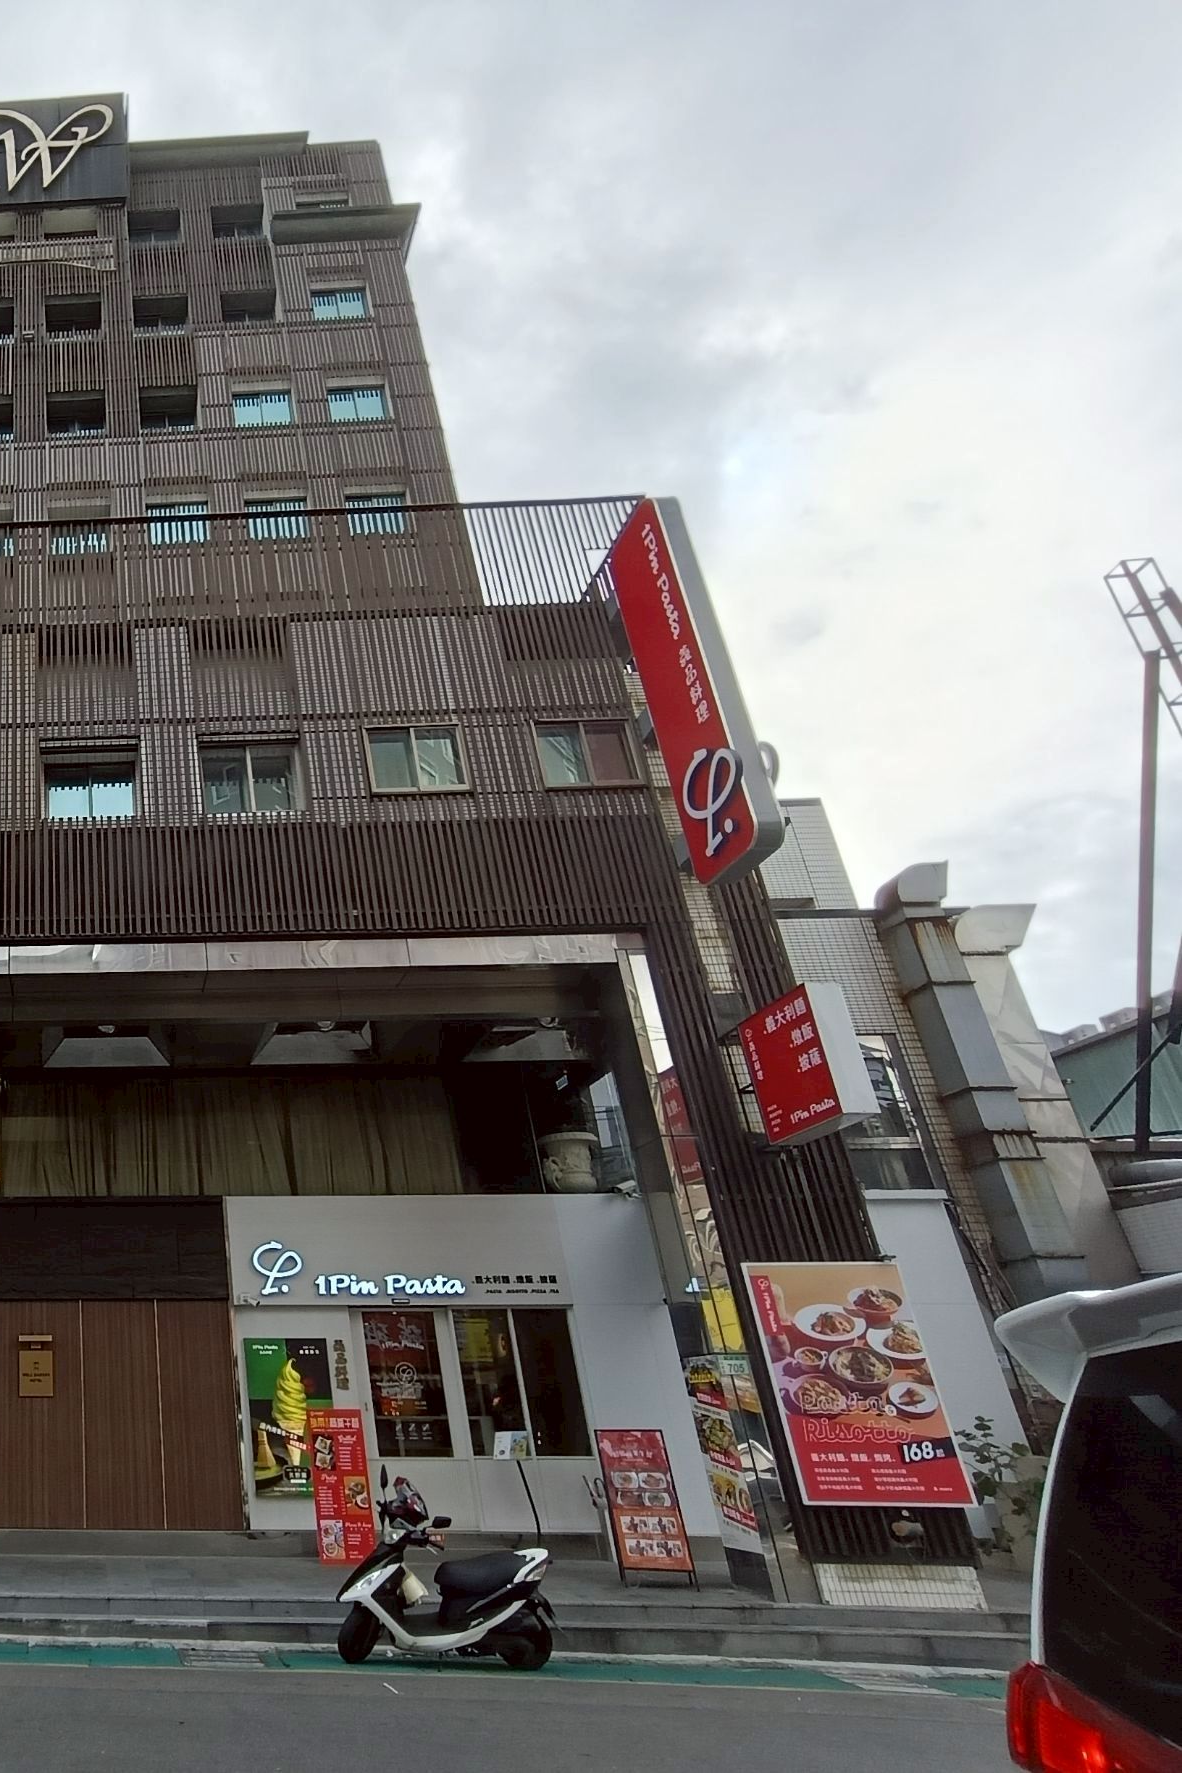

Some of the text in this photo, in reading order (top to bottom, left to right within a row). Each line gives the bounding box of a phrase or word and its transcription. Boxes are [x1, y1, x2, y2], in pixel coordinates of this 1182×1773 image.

[641, 523, 681, 640] 1Pin Pasta
[809, 1098, 836, 1116] Pasta
[314, 1273, 467, 1296] 1Pin Pasta
[727, 1363, 745, 1374] 705
[803, 1417, 915, 1443] Risotto
[903, 1441, 935, 1463] 168
